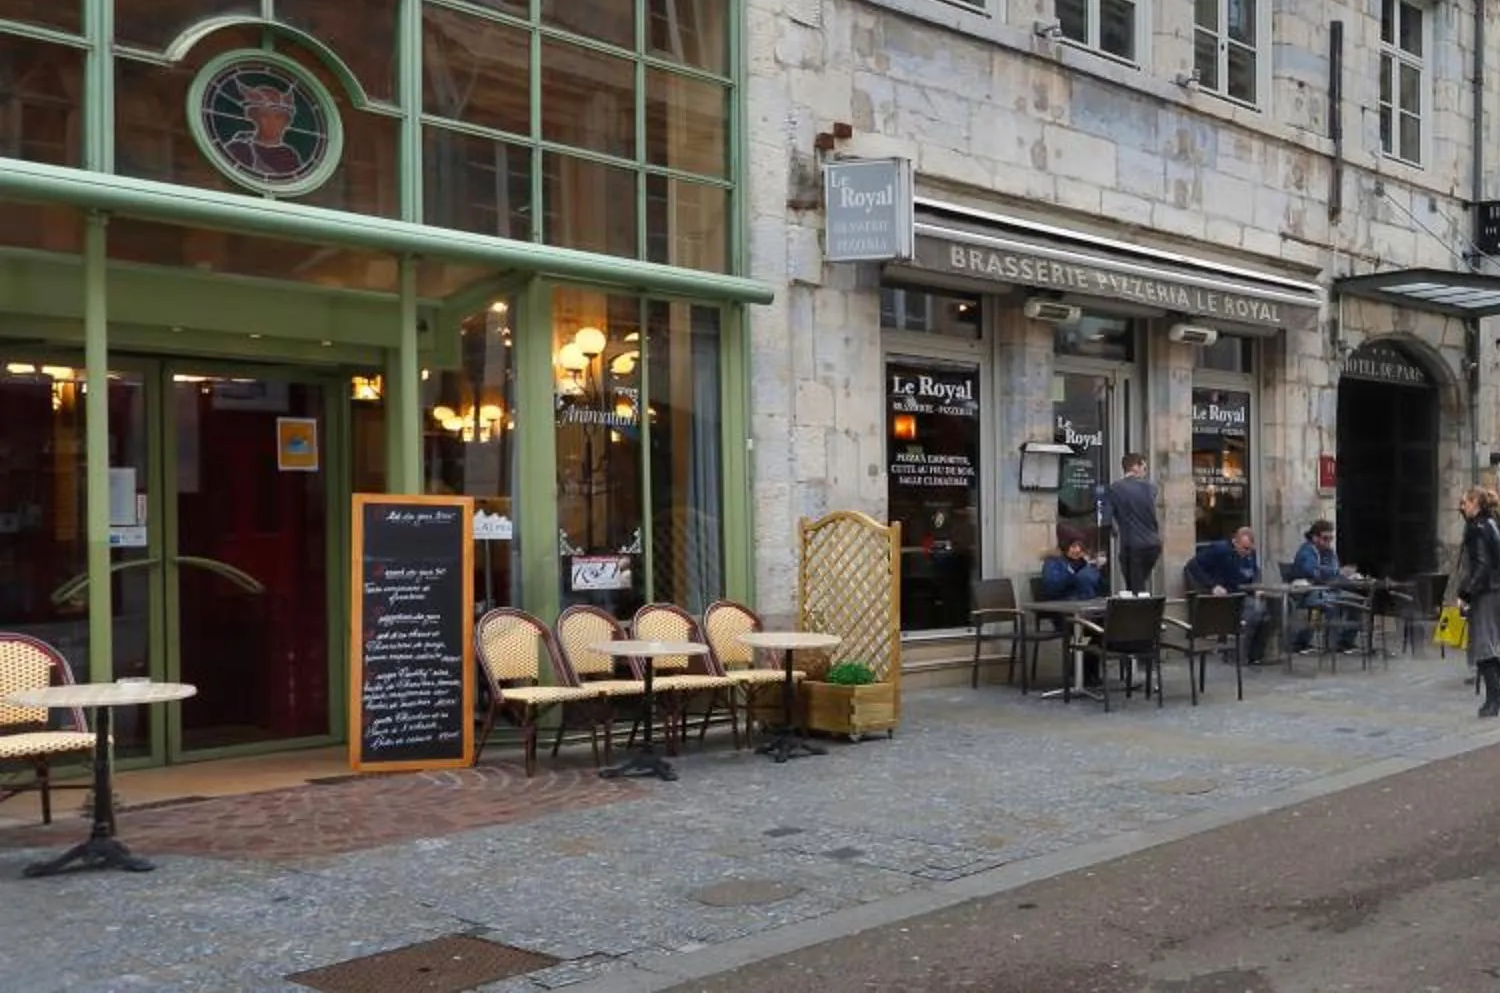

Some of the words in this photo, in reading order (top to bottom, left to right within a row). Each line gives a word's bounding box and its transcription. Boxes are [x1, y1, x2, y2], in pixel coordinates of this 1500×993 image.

[840, 184, 893, 215] Royal
[950, 245, 1089, 289] BRASSERIE
[1098, 272, 1191, 308] PIZZERIA
[1197, 290, 1218, 312] LE
[1223, 294, 1282, 323] ROYAL
[892, 376, 915, 395] Le
[918, 375, 973, 405] Royal
[1209, 404, 1245, 427] Royal
[1065, 429, 1103, 450] Royal
